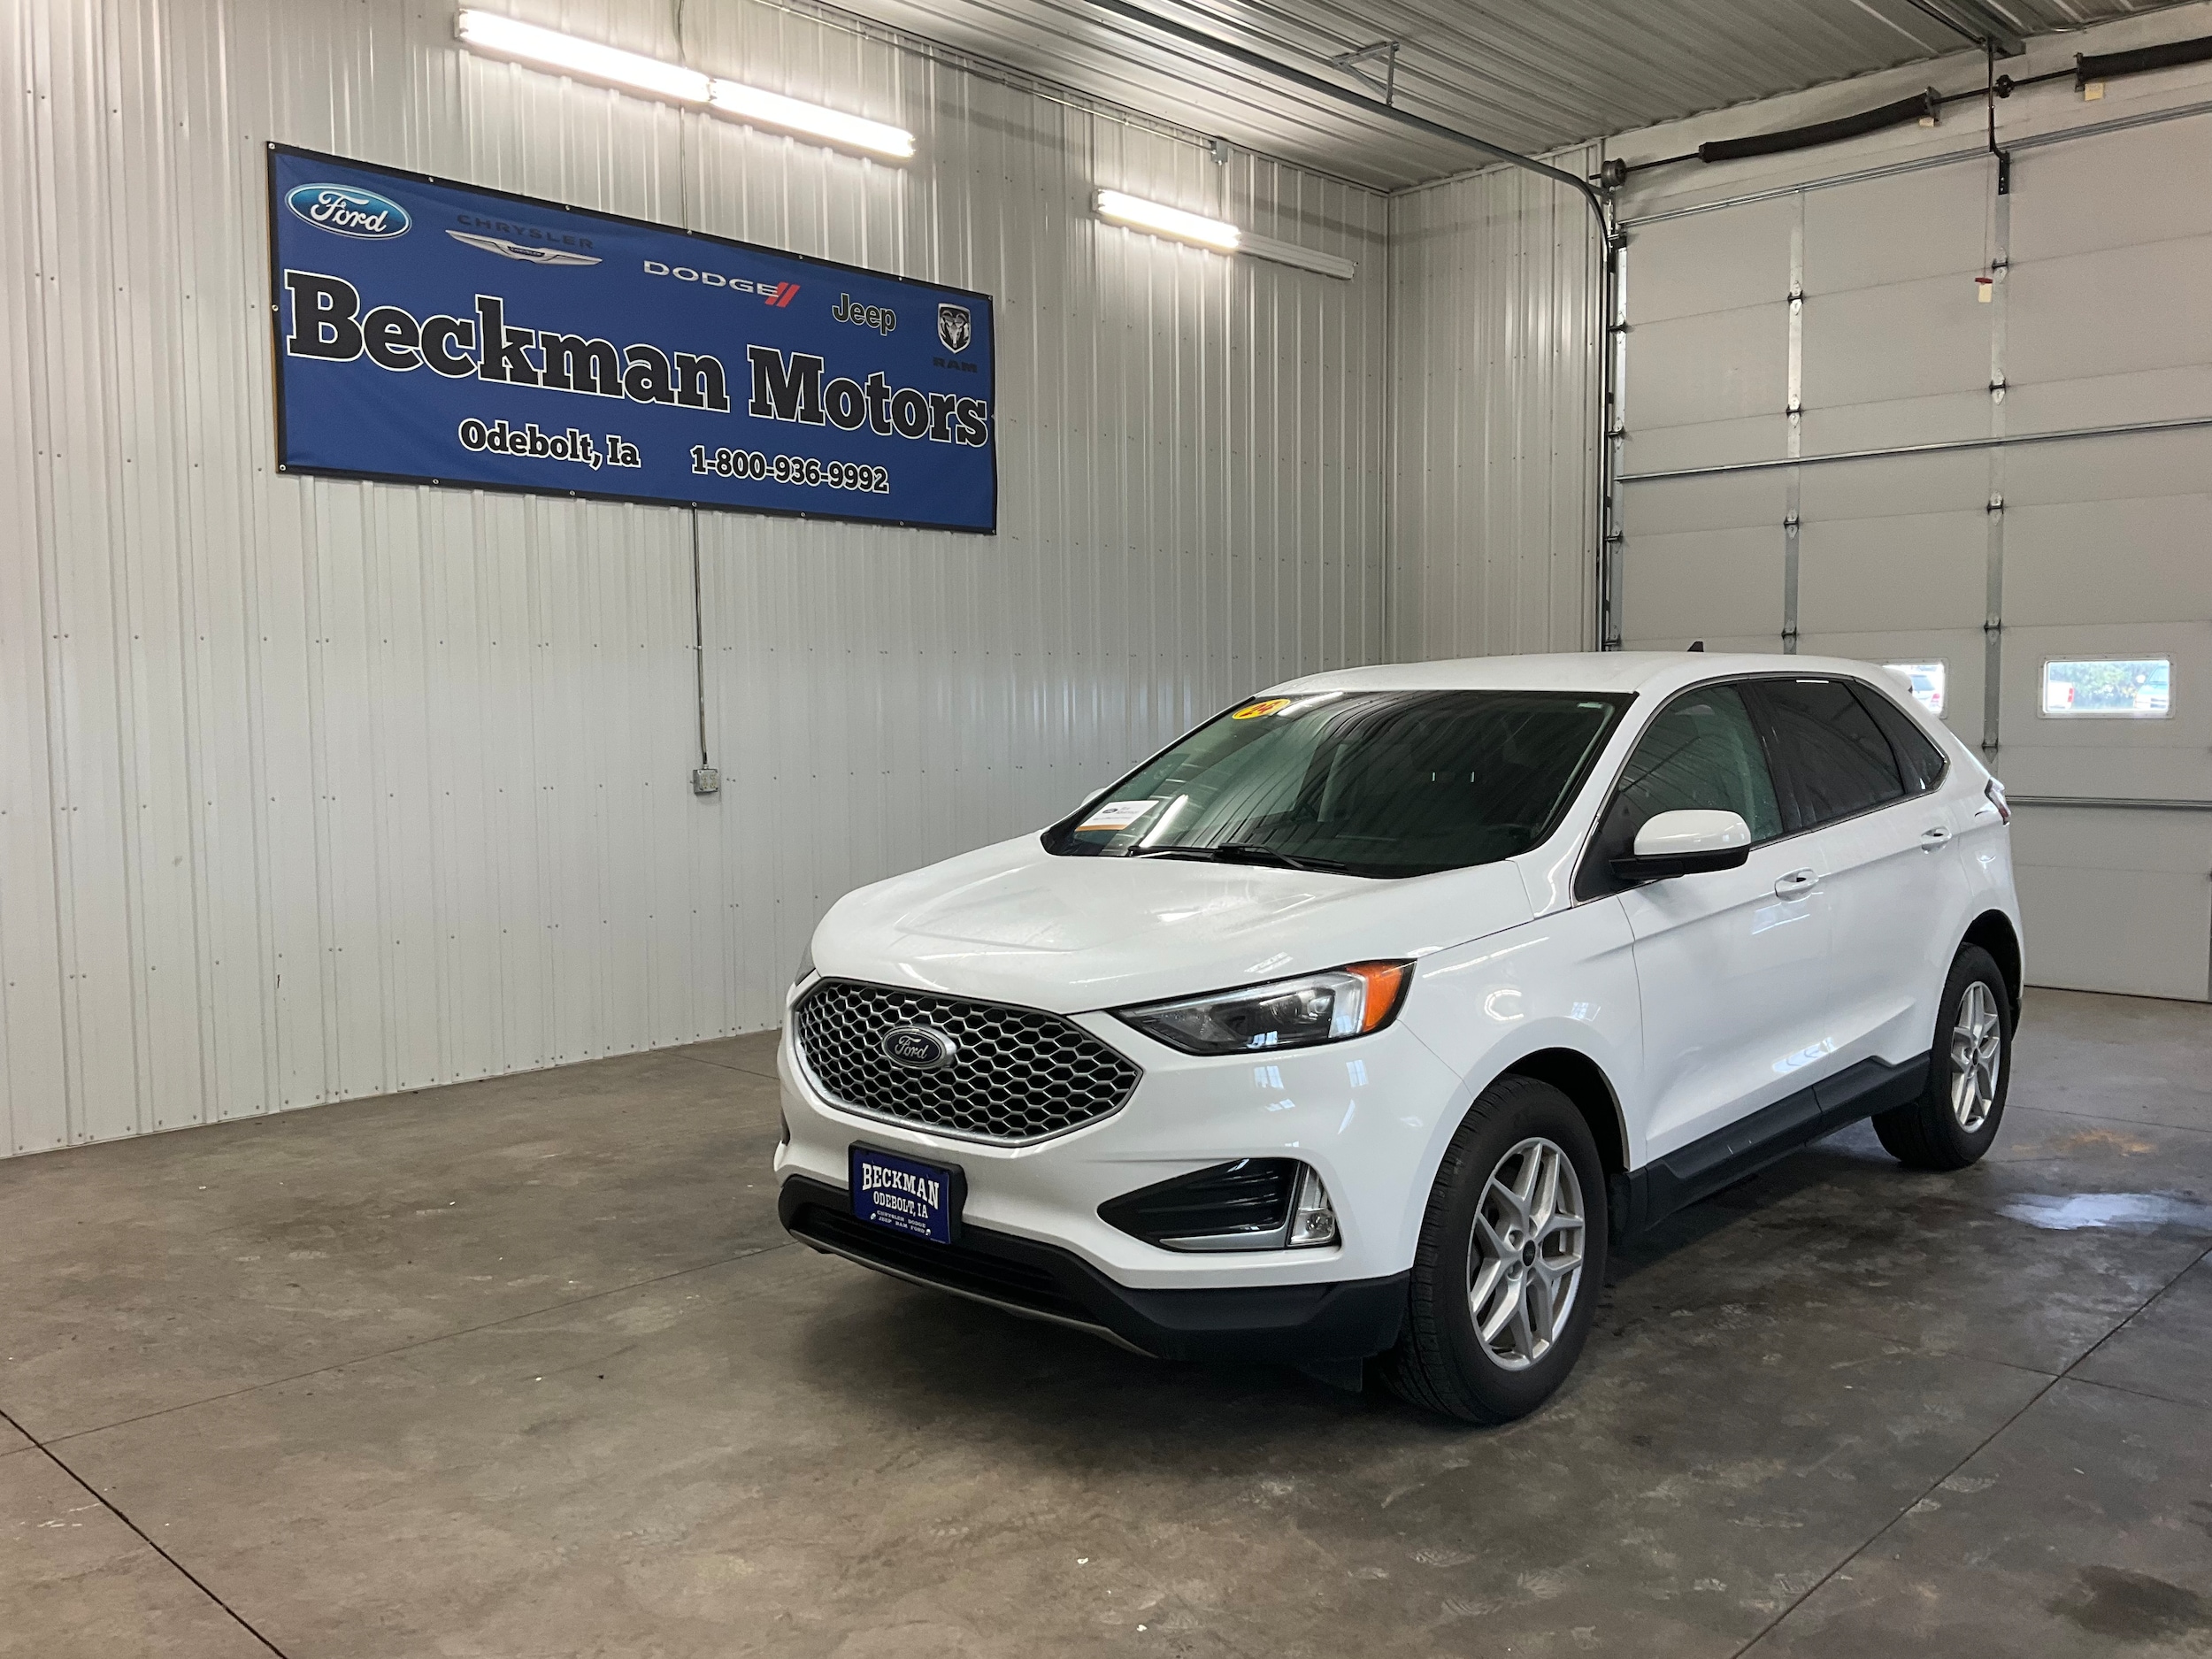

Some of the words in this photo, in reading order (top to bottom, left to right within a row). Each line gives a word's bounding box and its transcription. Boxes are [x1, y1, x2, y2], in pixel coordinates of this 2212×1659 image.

[310, 188, 388, 234] Ford
[457, 214, 595, 250] CHRYSLER
[643, 260, 780, 297] DODGE
[832, 293, 897, 336] Jeep
[283, 268, 730, 414] Beckman
[746, 343, 989, 448] Motors
[932, 357, 979, 373] RAM
[458, 418, 603, 471] Odebolt,
[606, 434, 641, 469] Ia
[690, 444, 890, 495] 1-800-936-9992
[894, 1034, 929, 1059] Ford
[862, 1162, 940, 1210] BECKMAN
[872, 1191, 917, 1217] ODEBOLT,
[918, 1202, 929, 1218] IA
